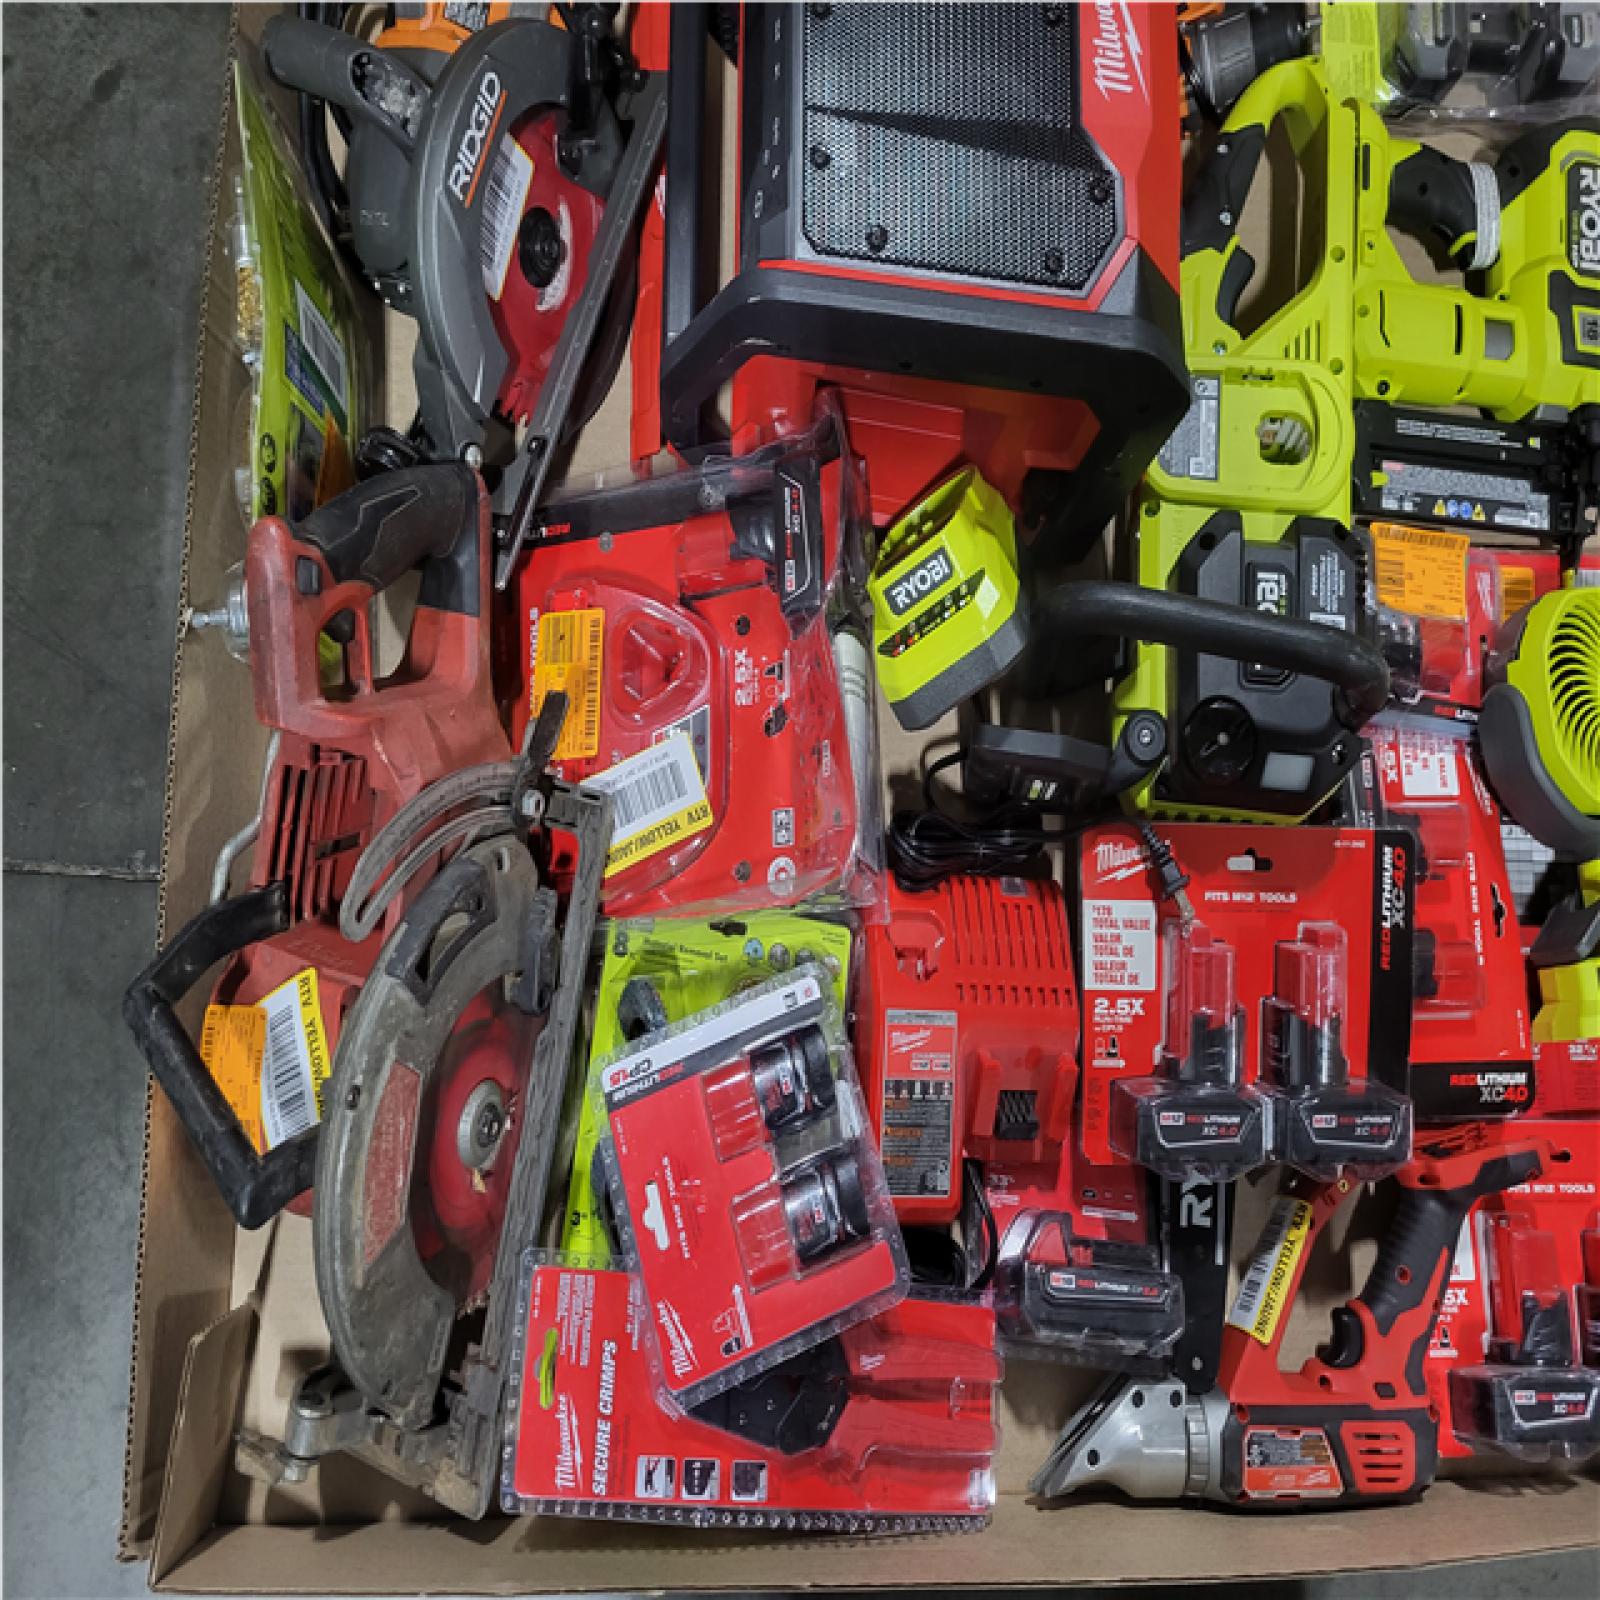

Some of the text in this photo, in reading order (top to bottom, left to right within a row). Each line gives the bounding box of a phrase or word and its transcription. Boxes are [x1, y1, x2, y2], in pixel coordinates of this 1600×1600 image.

[449, 72, 500, 201] RIDGID
[1579, 167, 1600, 271] RYOBI
[891, 554, 951, 608] RYOBI
[1092, 918, 1151, 930] TOTAL VALUE
[1259, 892, 1297, 904] TOOLS
[1380, 845, 1395, 970] REDLITHIUM
[1094, 997, 1145, 1016] 2.5X
[554, 1393, 577, 1489] Milwaukee
[591, 1339, 617, 1496] SECURE CRIMPS
